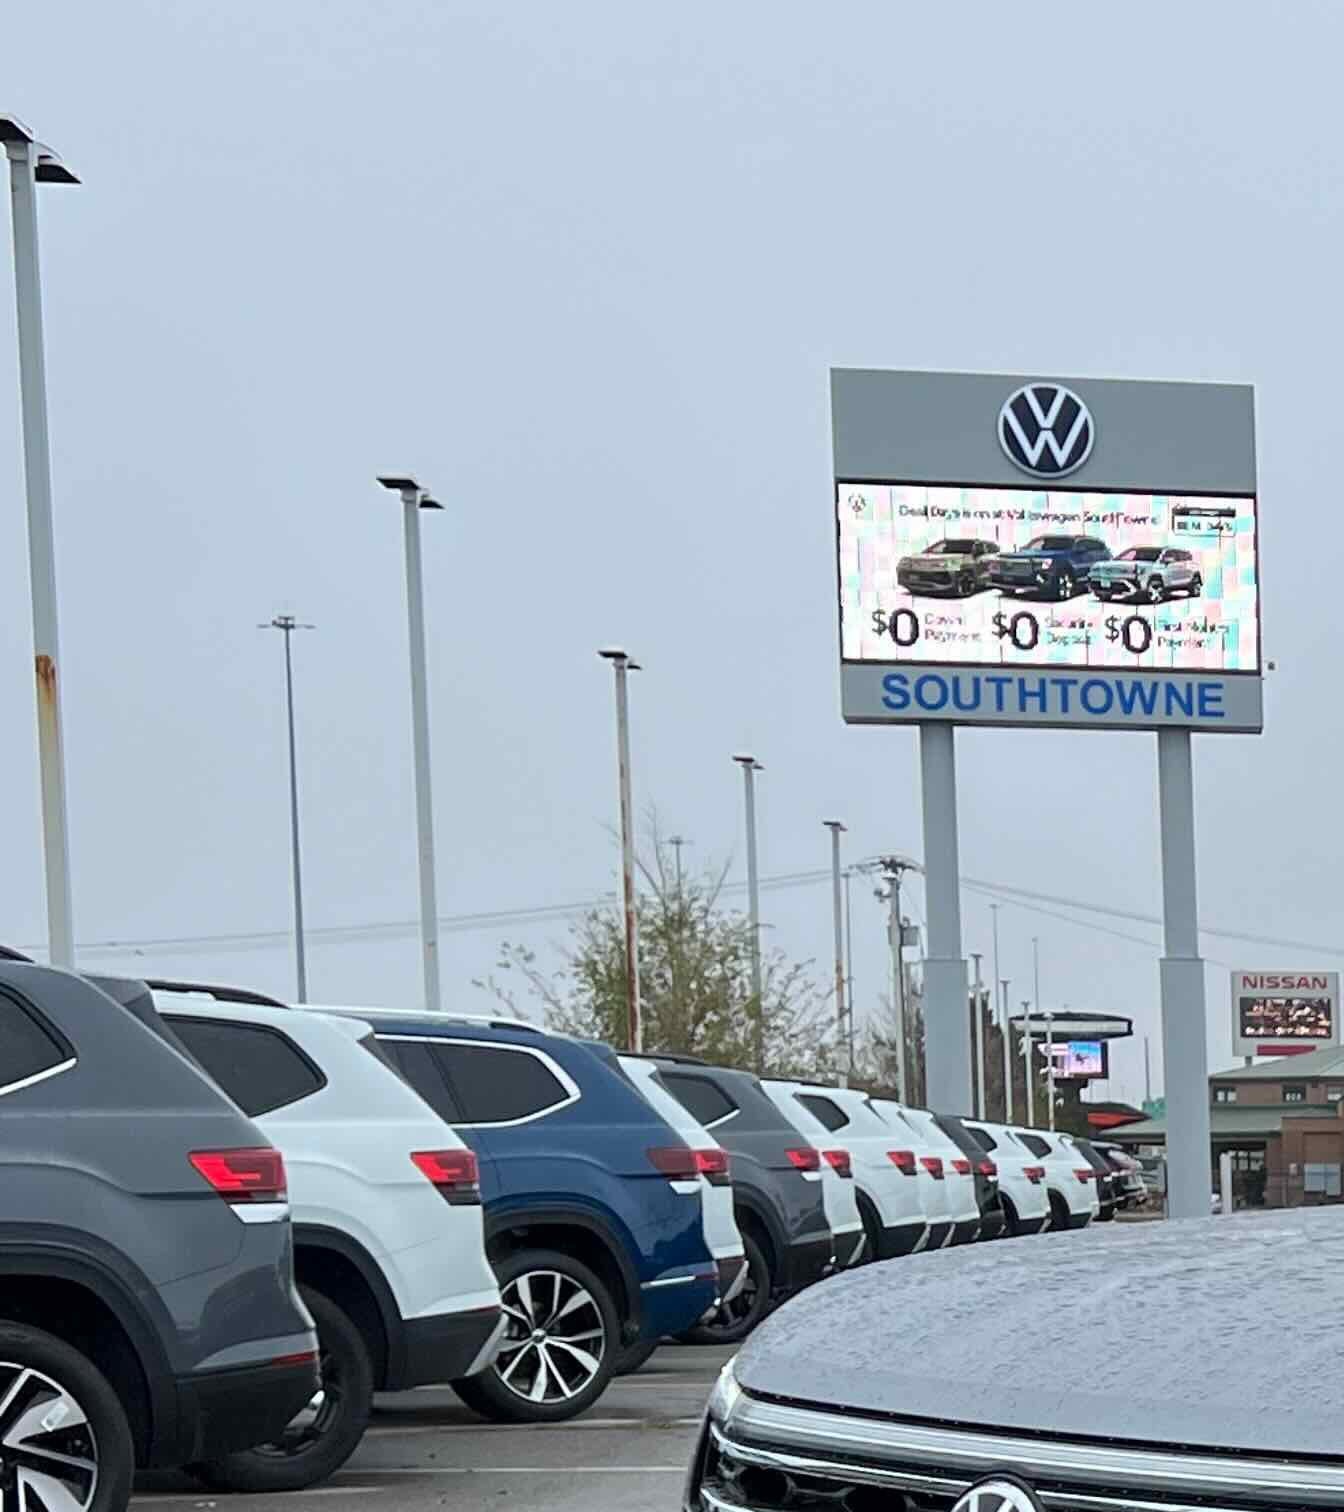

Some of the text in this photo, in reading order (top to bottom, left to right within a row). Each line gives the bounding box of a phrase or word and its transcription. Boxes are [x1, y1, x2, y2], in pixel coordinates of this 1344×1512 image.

[1000, 384, 1092, 473] VW
[872, 608, 919, 647] $0
[992, 611, 1039, 650] $0
[1105, 615, 1152, 654] $0
[881, 673, 1226, 719] SOUTHTOWNE
[1242, 975, 1328, 990] NISSAN
